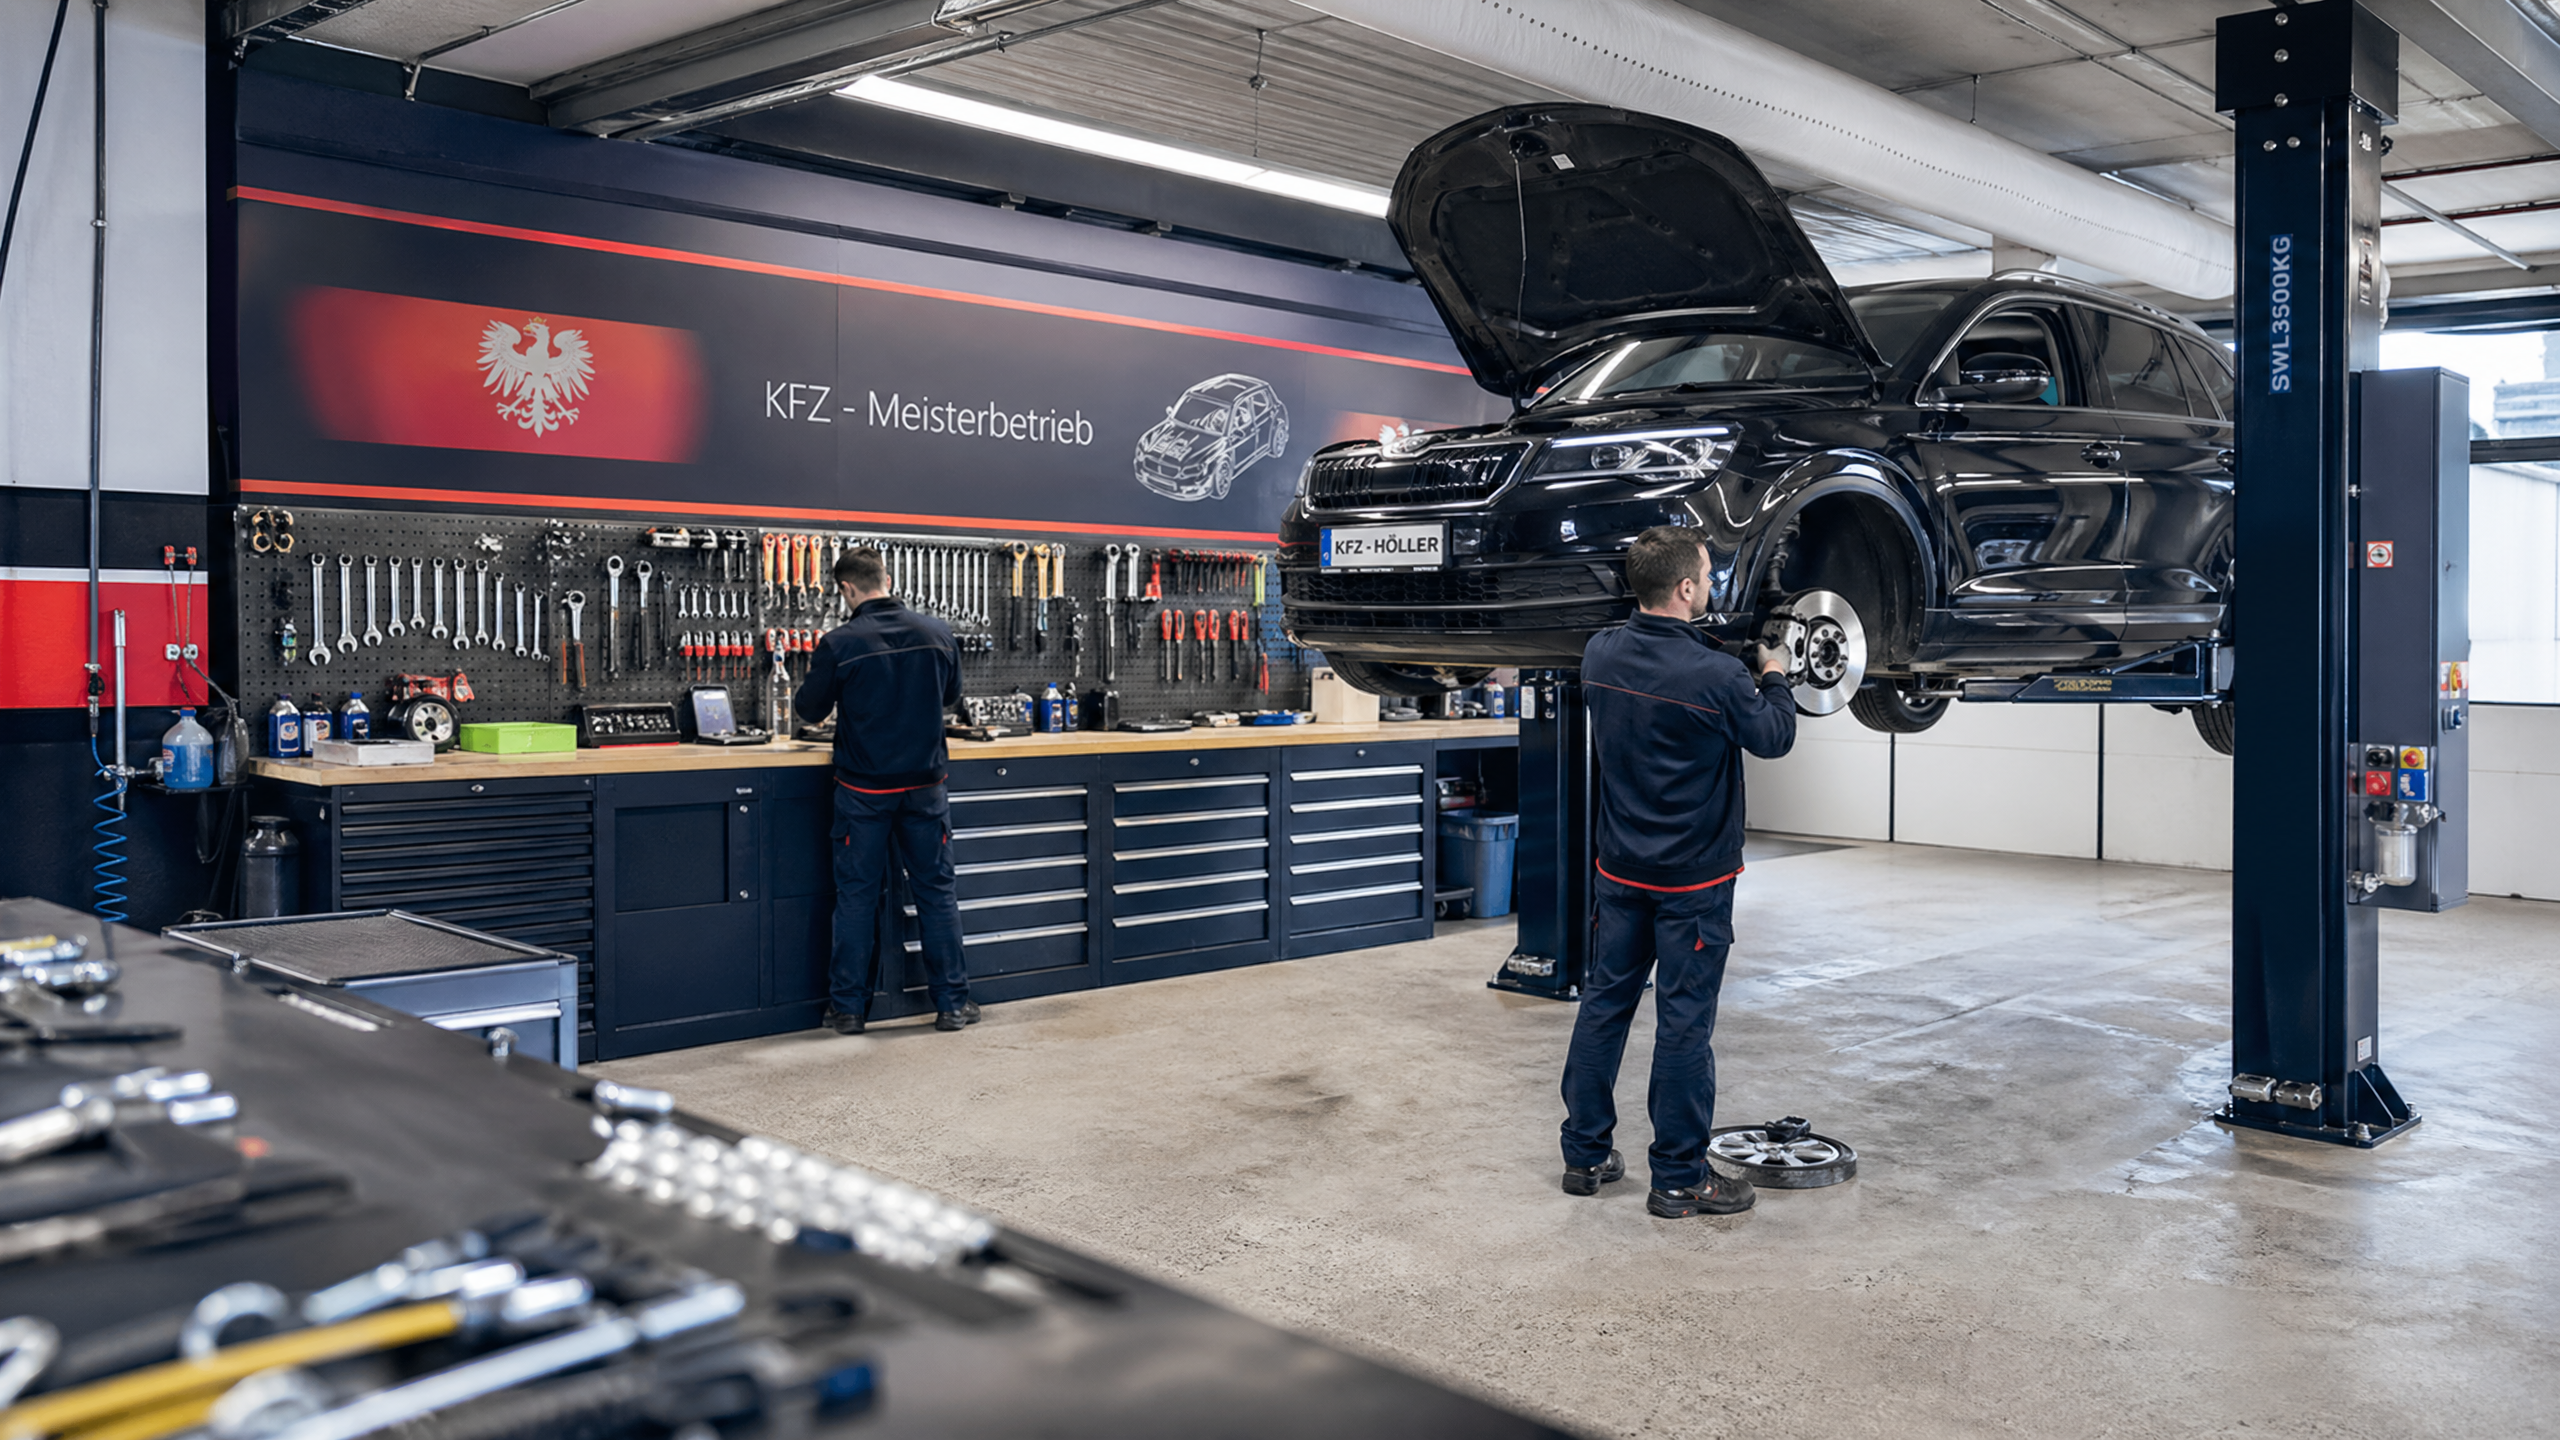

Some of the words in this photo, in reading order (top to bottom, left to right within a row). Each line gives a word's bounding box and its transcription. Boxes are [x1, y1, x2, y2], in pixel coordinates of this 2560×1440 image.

[765, 380, 832, 423] KFZ
[868, 389, 1094, 446] Meisterbetrieb
[1335, 539, 1363, 555] KFZ
[1374, 533, 1439, 554] HÖLLER
